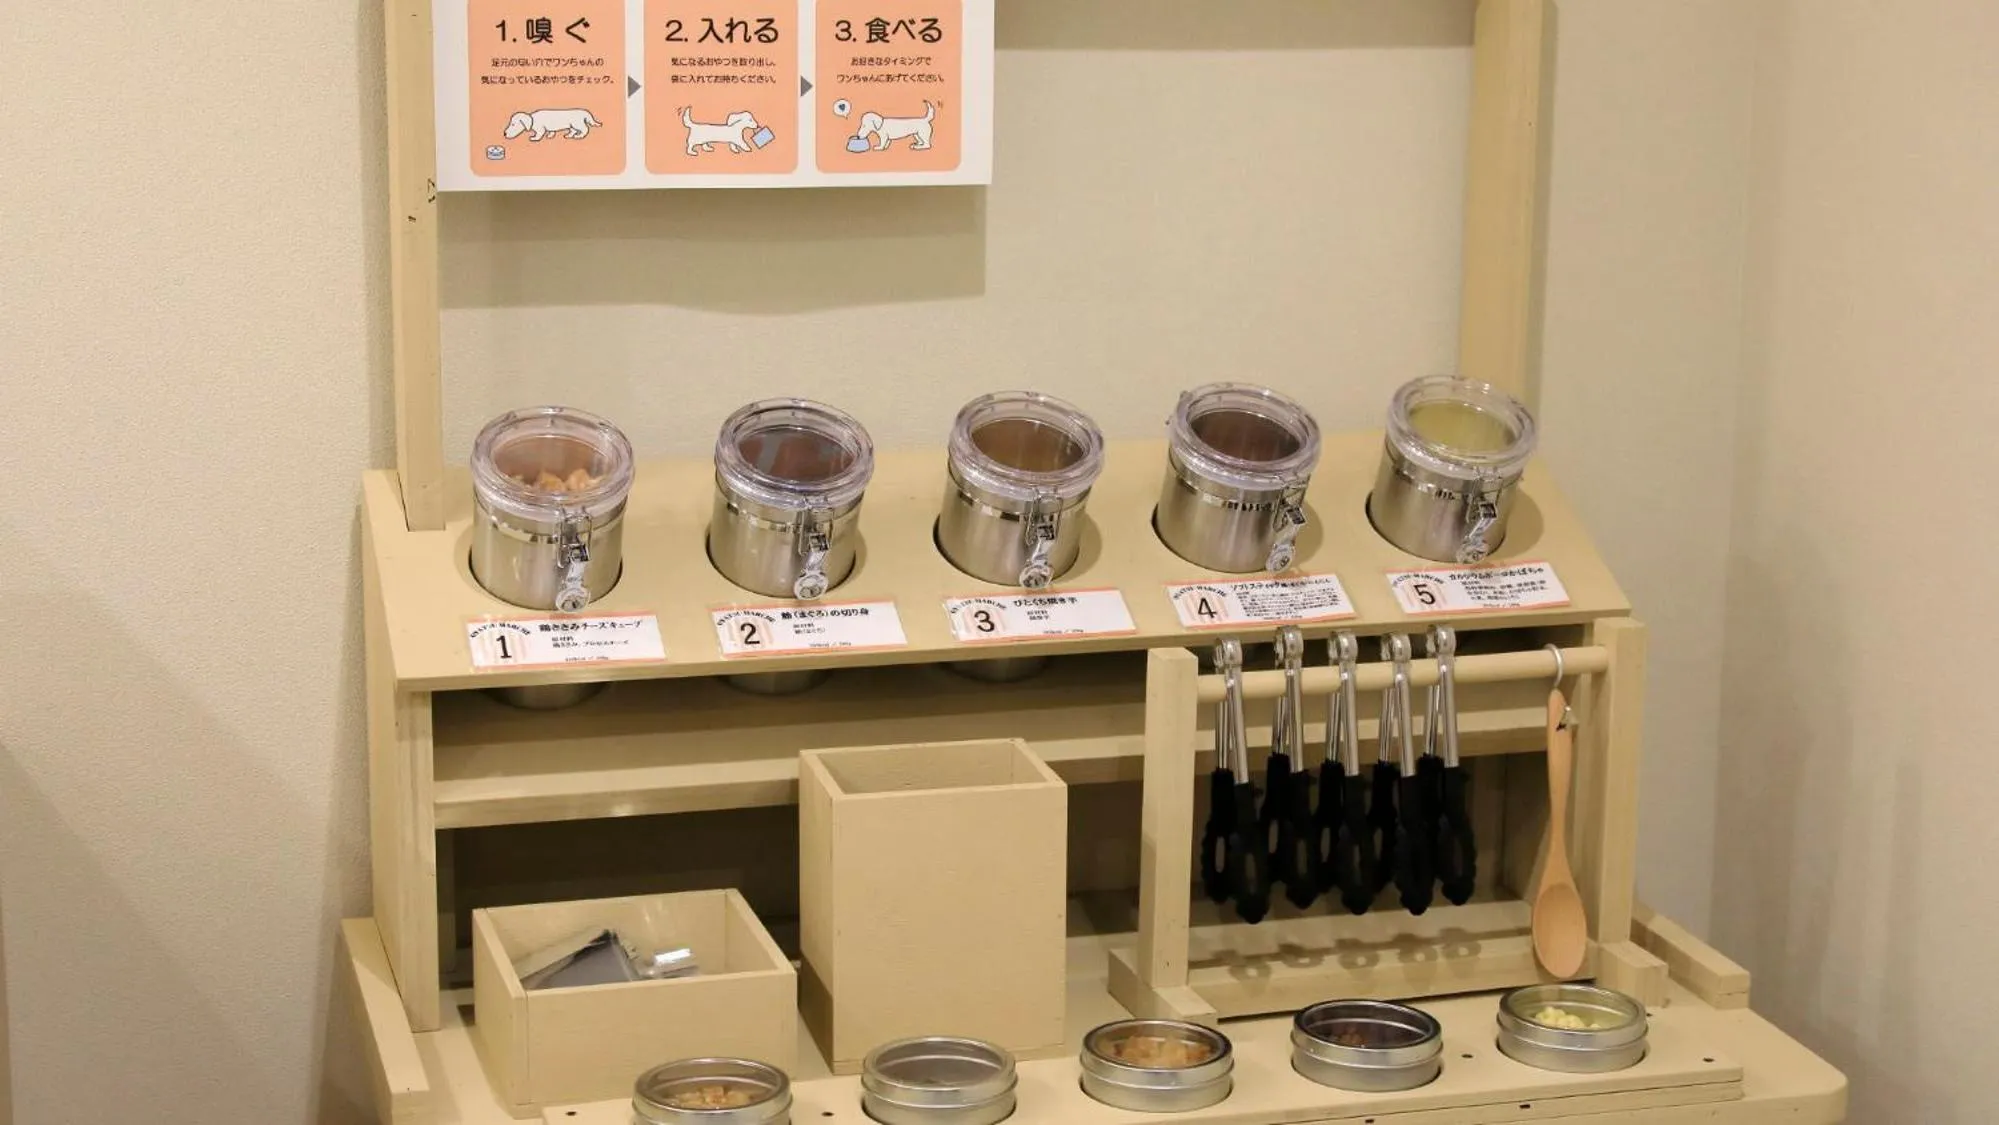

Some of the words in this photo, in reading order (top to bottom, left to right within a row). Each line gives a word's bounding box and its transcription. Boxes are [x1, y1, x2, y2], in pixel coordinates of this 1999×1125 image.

[698, 17, 779, 44] 入れる
[865, 17, 943, 44] 食べる
[1413, 583, 1436, 606] 5
[1197, 597, 1218, 619] 4
[973, 609, 996, 633] 3
[740, 622, 761, 645] 2
[496, 634, 513, 660] 1
